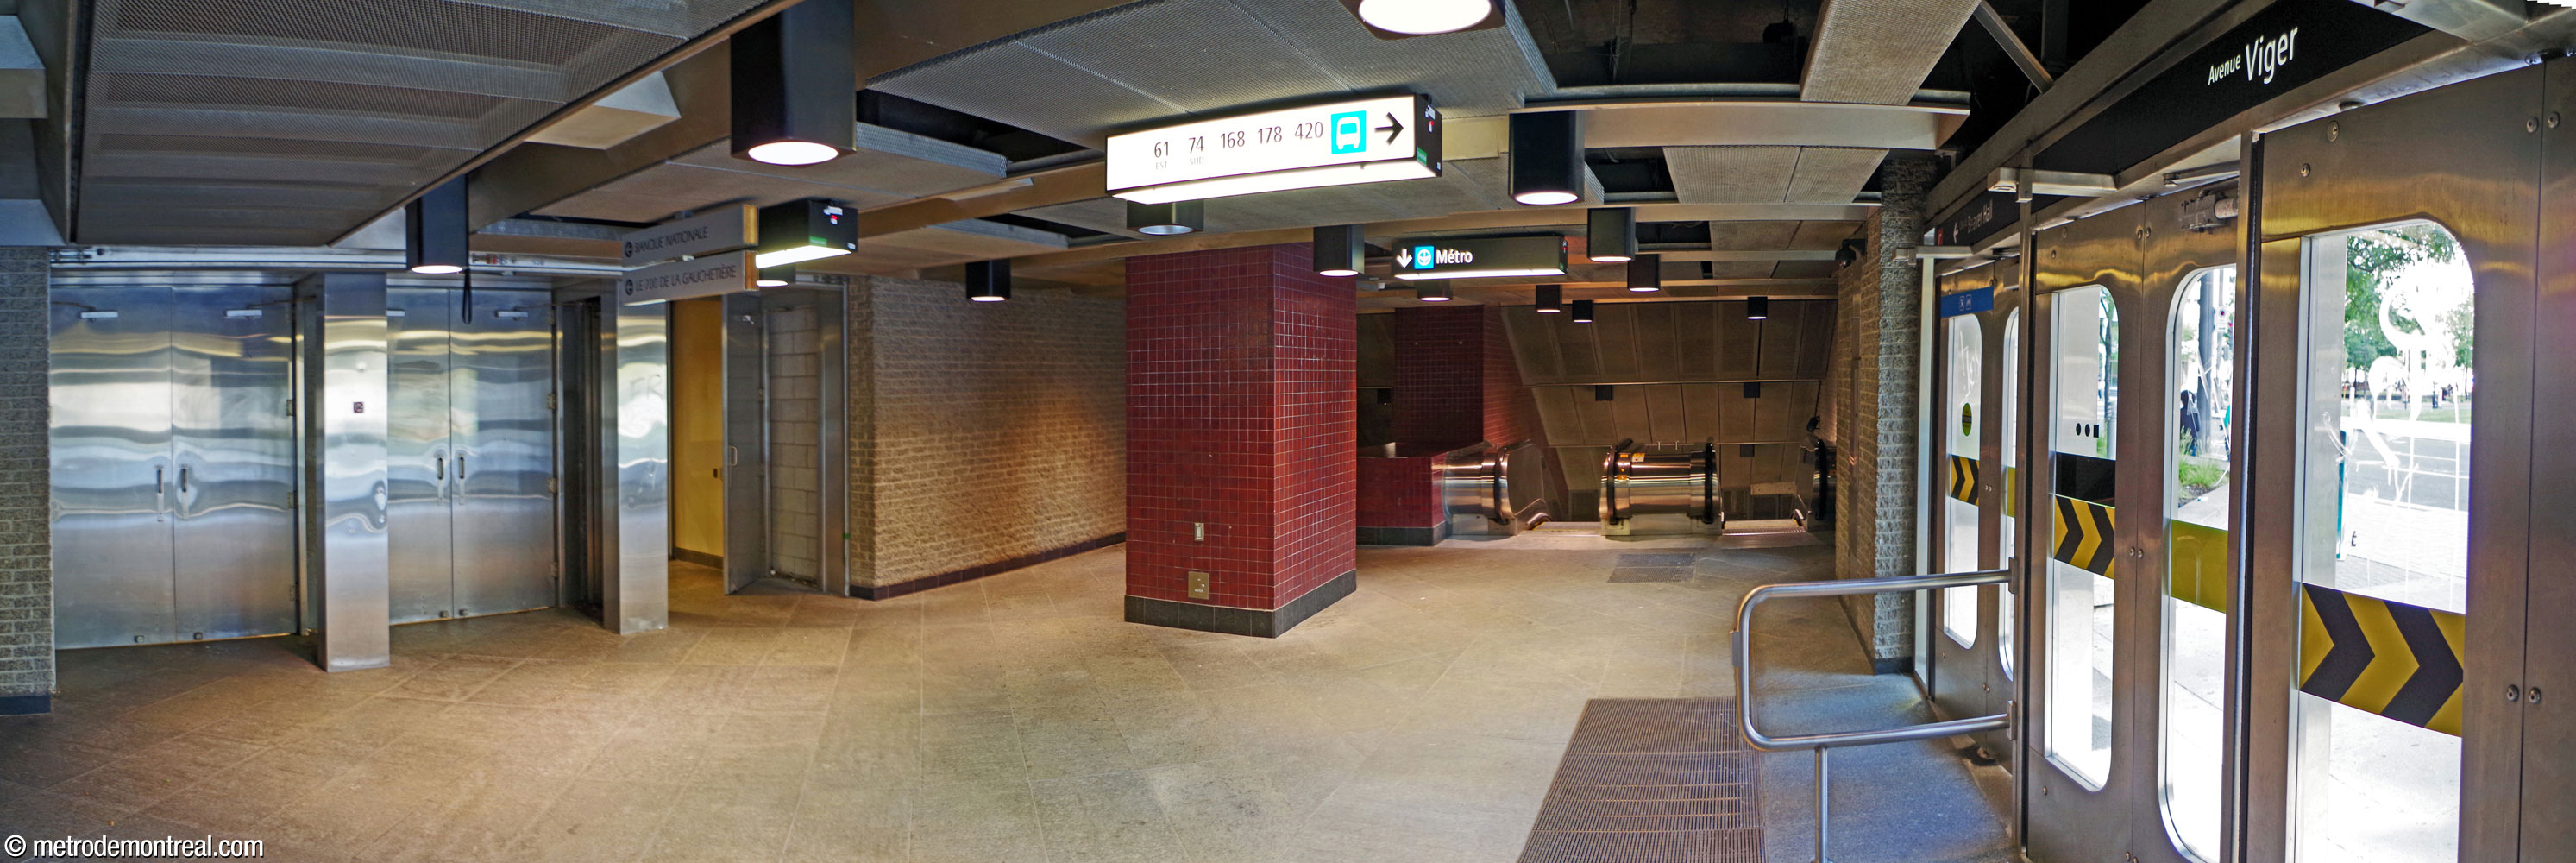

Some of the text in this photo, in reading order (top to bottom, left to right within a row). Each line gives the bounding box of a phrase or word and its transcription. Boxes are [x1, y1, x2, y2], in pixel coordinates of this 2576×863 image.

[2208, 26, 2298, 85] Avenue Viger
[1153, 121, 1324, 158] 61 74 168 178 420
[1155, 156, 1204, 170] EST SUD
[634, 226, 709, 254] BANQUE NATIONALE
[1436, 248, 1473, 265] Métro
[635, 280, 644, 292] LE
[660, 275, 670, 288] DE
[672, 274, 682, 287] LA
[682, 264, 738, 285] GAUCHETIÈRE
